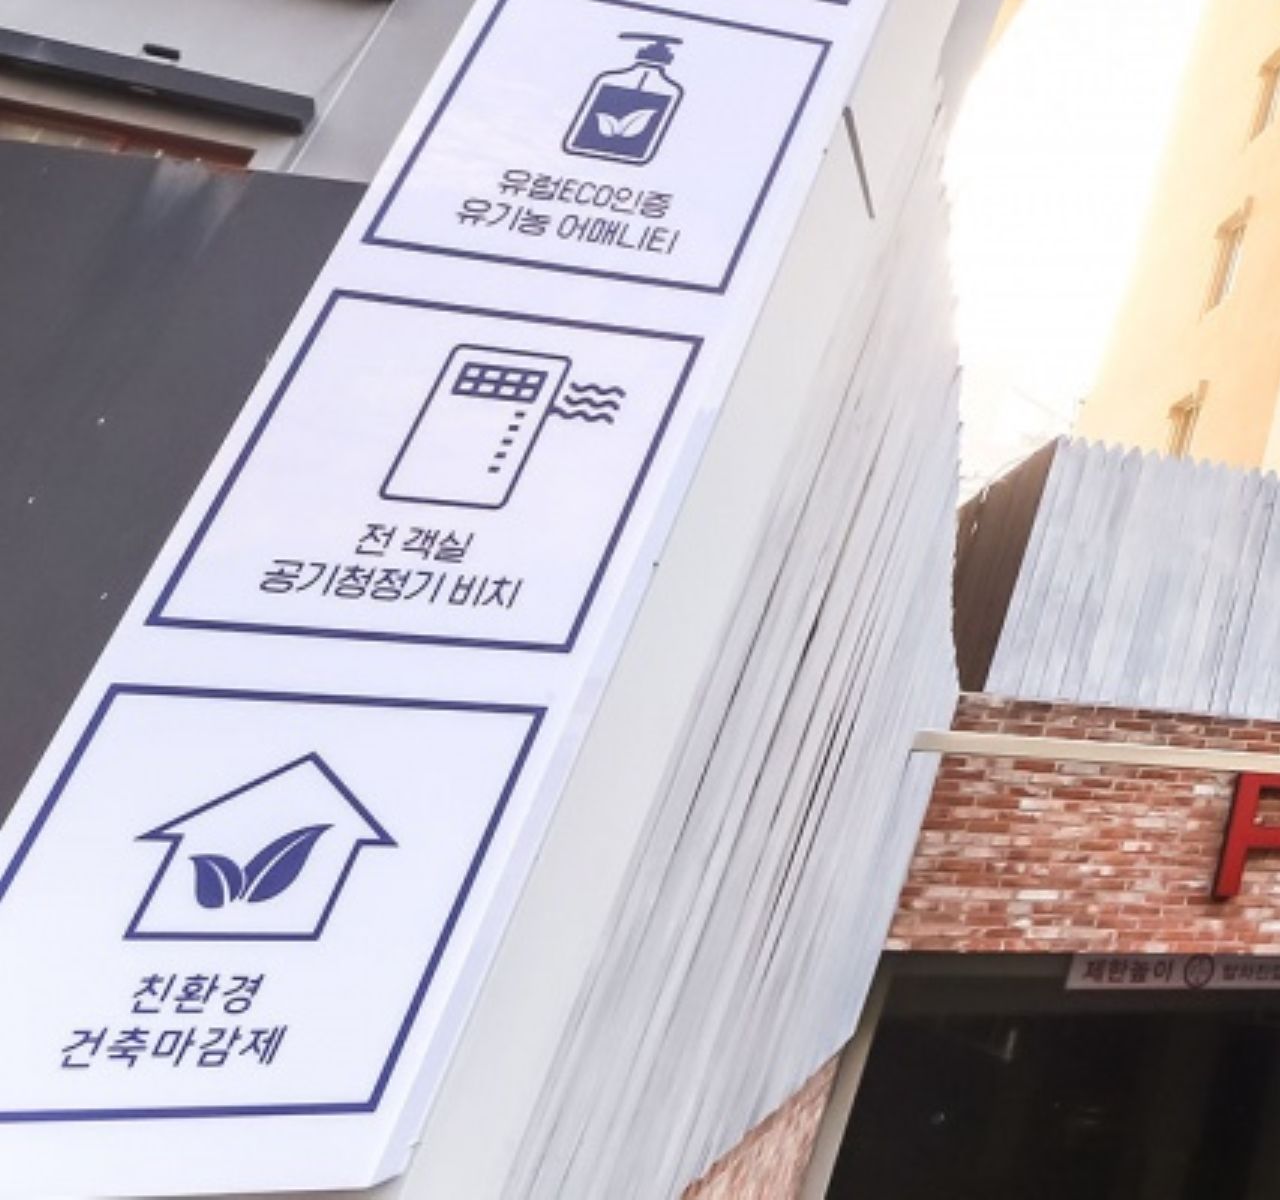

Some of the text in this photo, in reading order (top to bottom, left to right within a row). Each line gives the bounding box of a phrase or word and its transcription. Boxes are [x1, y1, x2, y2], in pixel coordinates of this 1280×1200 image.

[498, 168, 674, 219] 유럽ECO인증
[456, 197, 681, 255] 유기농 어매니티
[355, 523, 475, 563] 전 객실
[259, 559, 524, 609] 공기청정기 비치
[1082, 957, 1175, 984] 제한높이
[131, 973, 265, 1015] 친환경
[61, 1024, 288, 1068] 건축마감제
